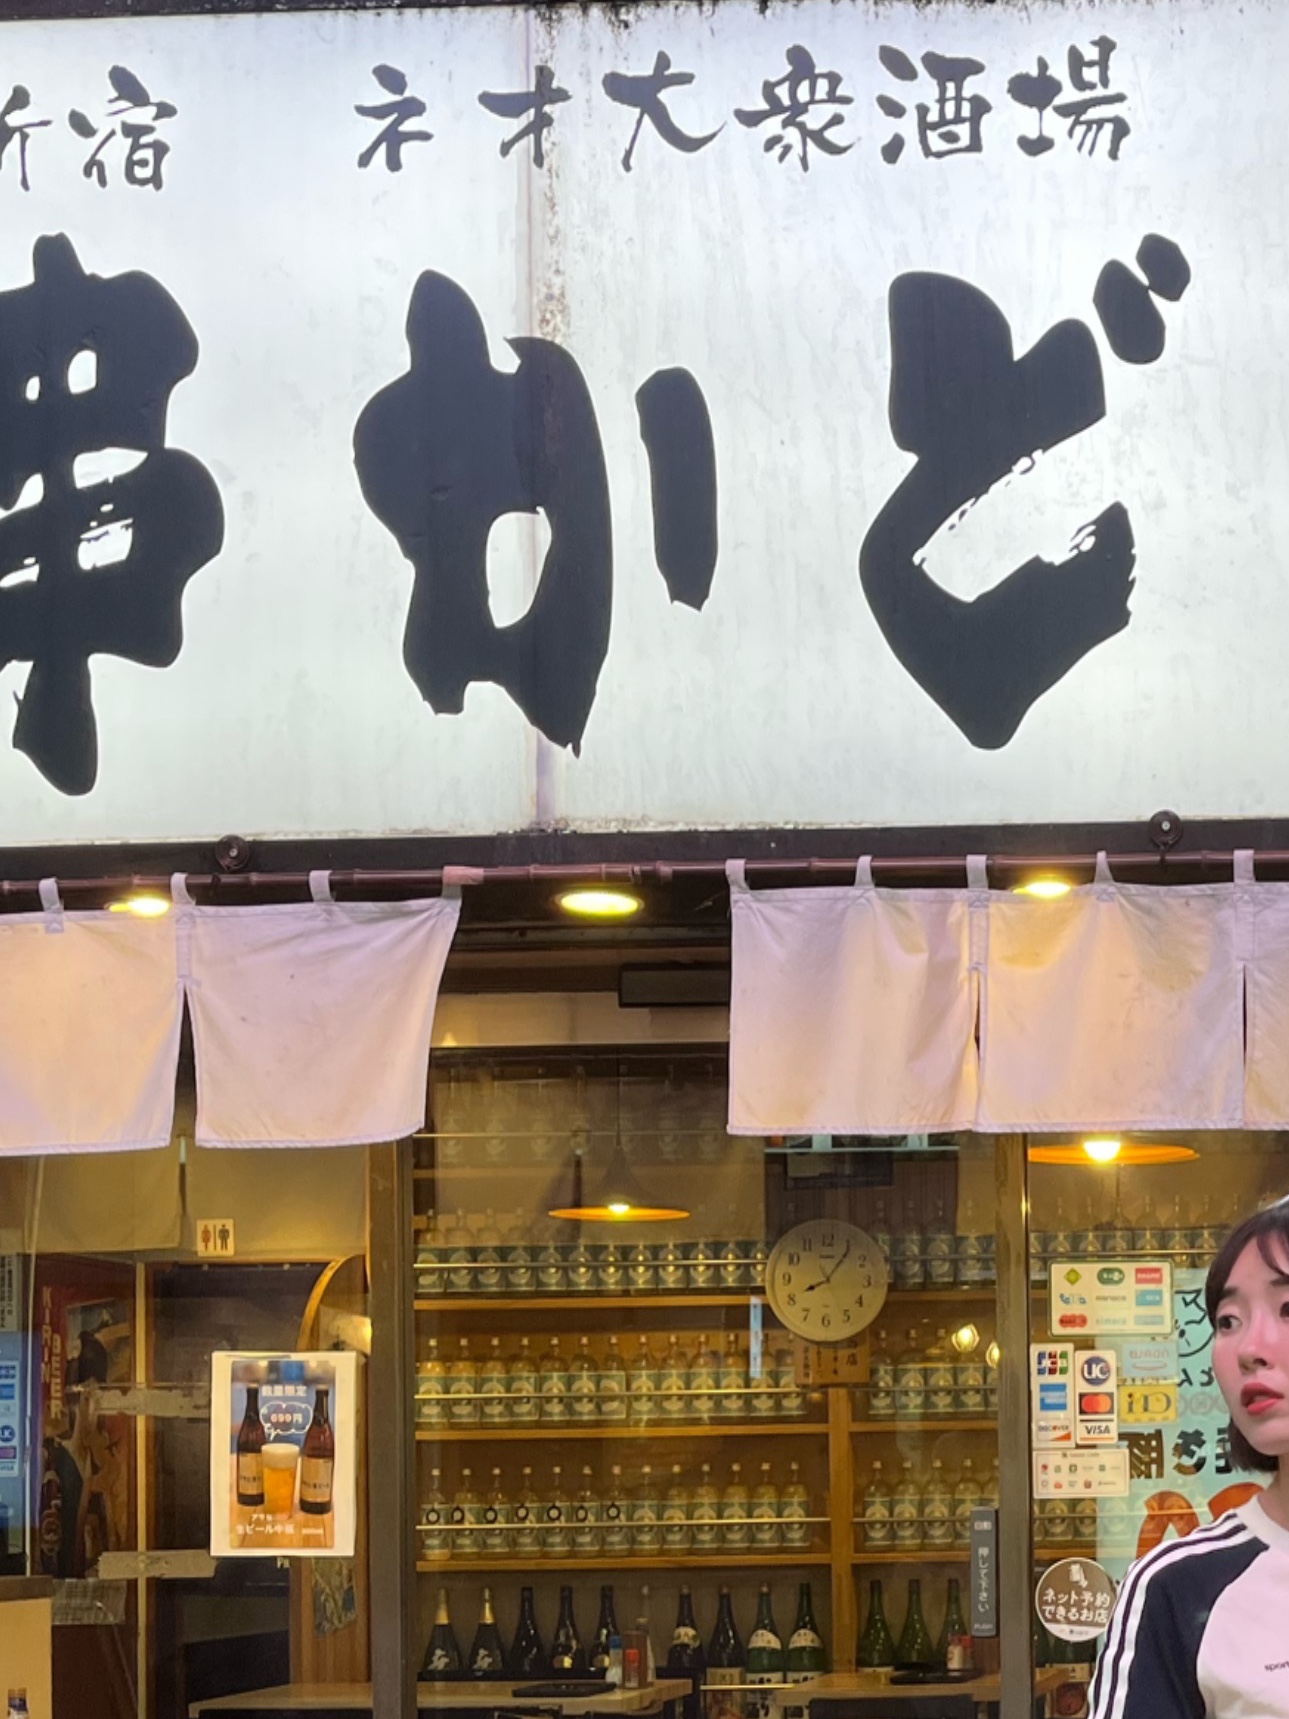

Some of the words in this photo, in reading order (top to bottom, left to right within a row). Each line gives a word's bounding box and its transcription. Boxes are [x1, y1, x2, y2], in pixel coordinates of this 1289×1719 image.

[801, 1237, 812, 1253] 11
[821, 1234, 835, 1248] 12
[787, 1252, 800, 1266] 10
[858, 1255, 867, 1269] 2
[782, 1273, 792, 1287] 9
[863, 1275, 872, 1289] 3
[787, 1293, 797, 1307] 8
[855, 1293, 864, 1308] 4
[801, 1308, 811, 1323] 7
[821, 1313, 831, 1329] 6
[842, 1309, 851, 1324] 5
[1082, 1362, 1109, 1380] UC
[1126, 1391, 1172, 1415] iD
[1084, 1425, 1112, 1435] VISA
[1042, 1587, 1111, 1608] ネット予約
[1041, 1605, 1109, 1624] できるお店
